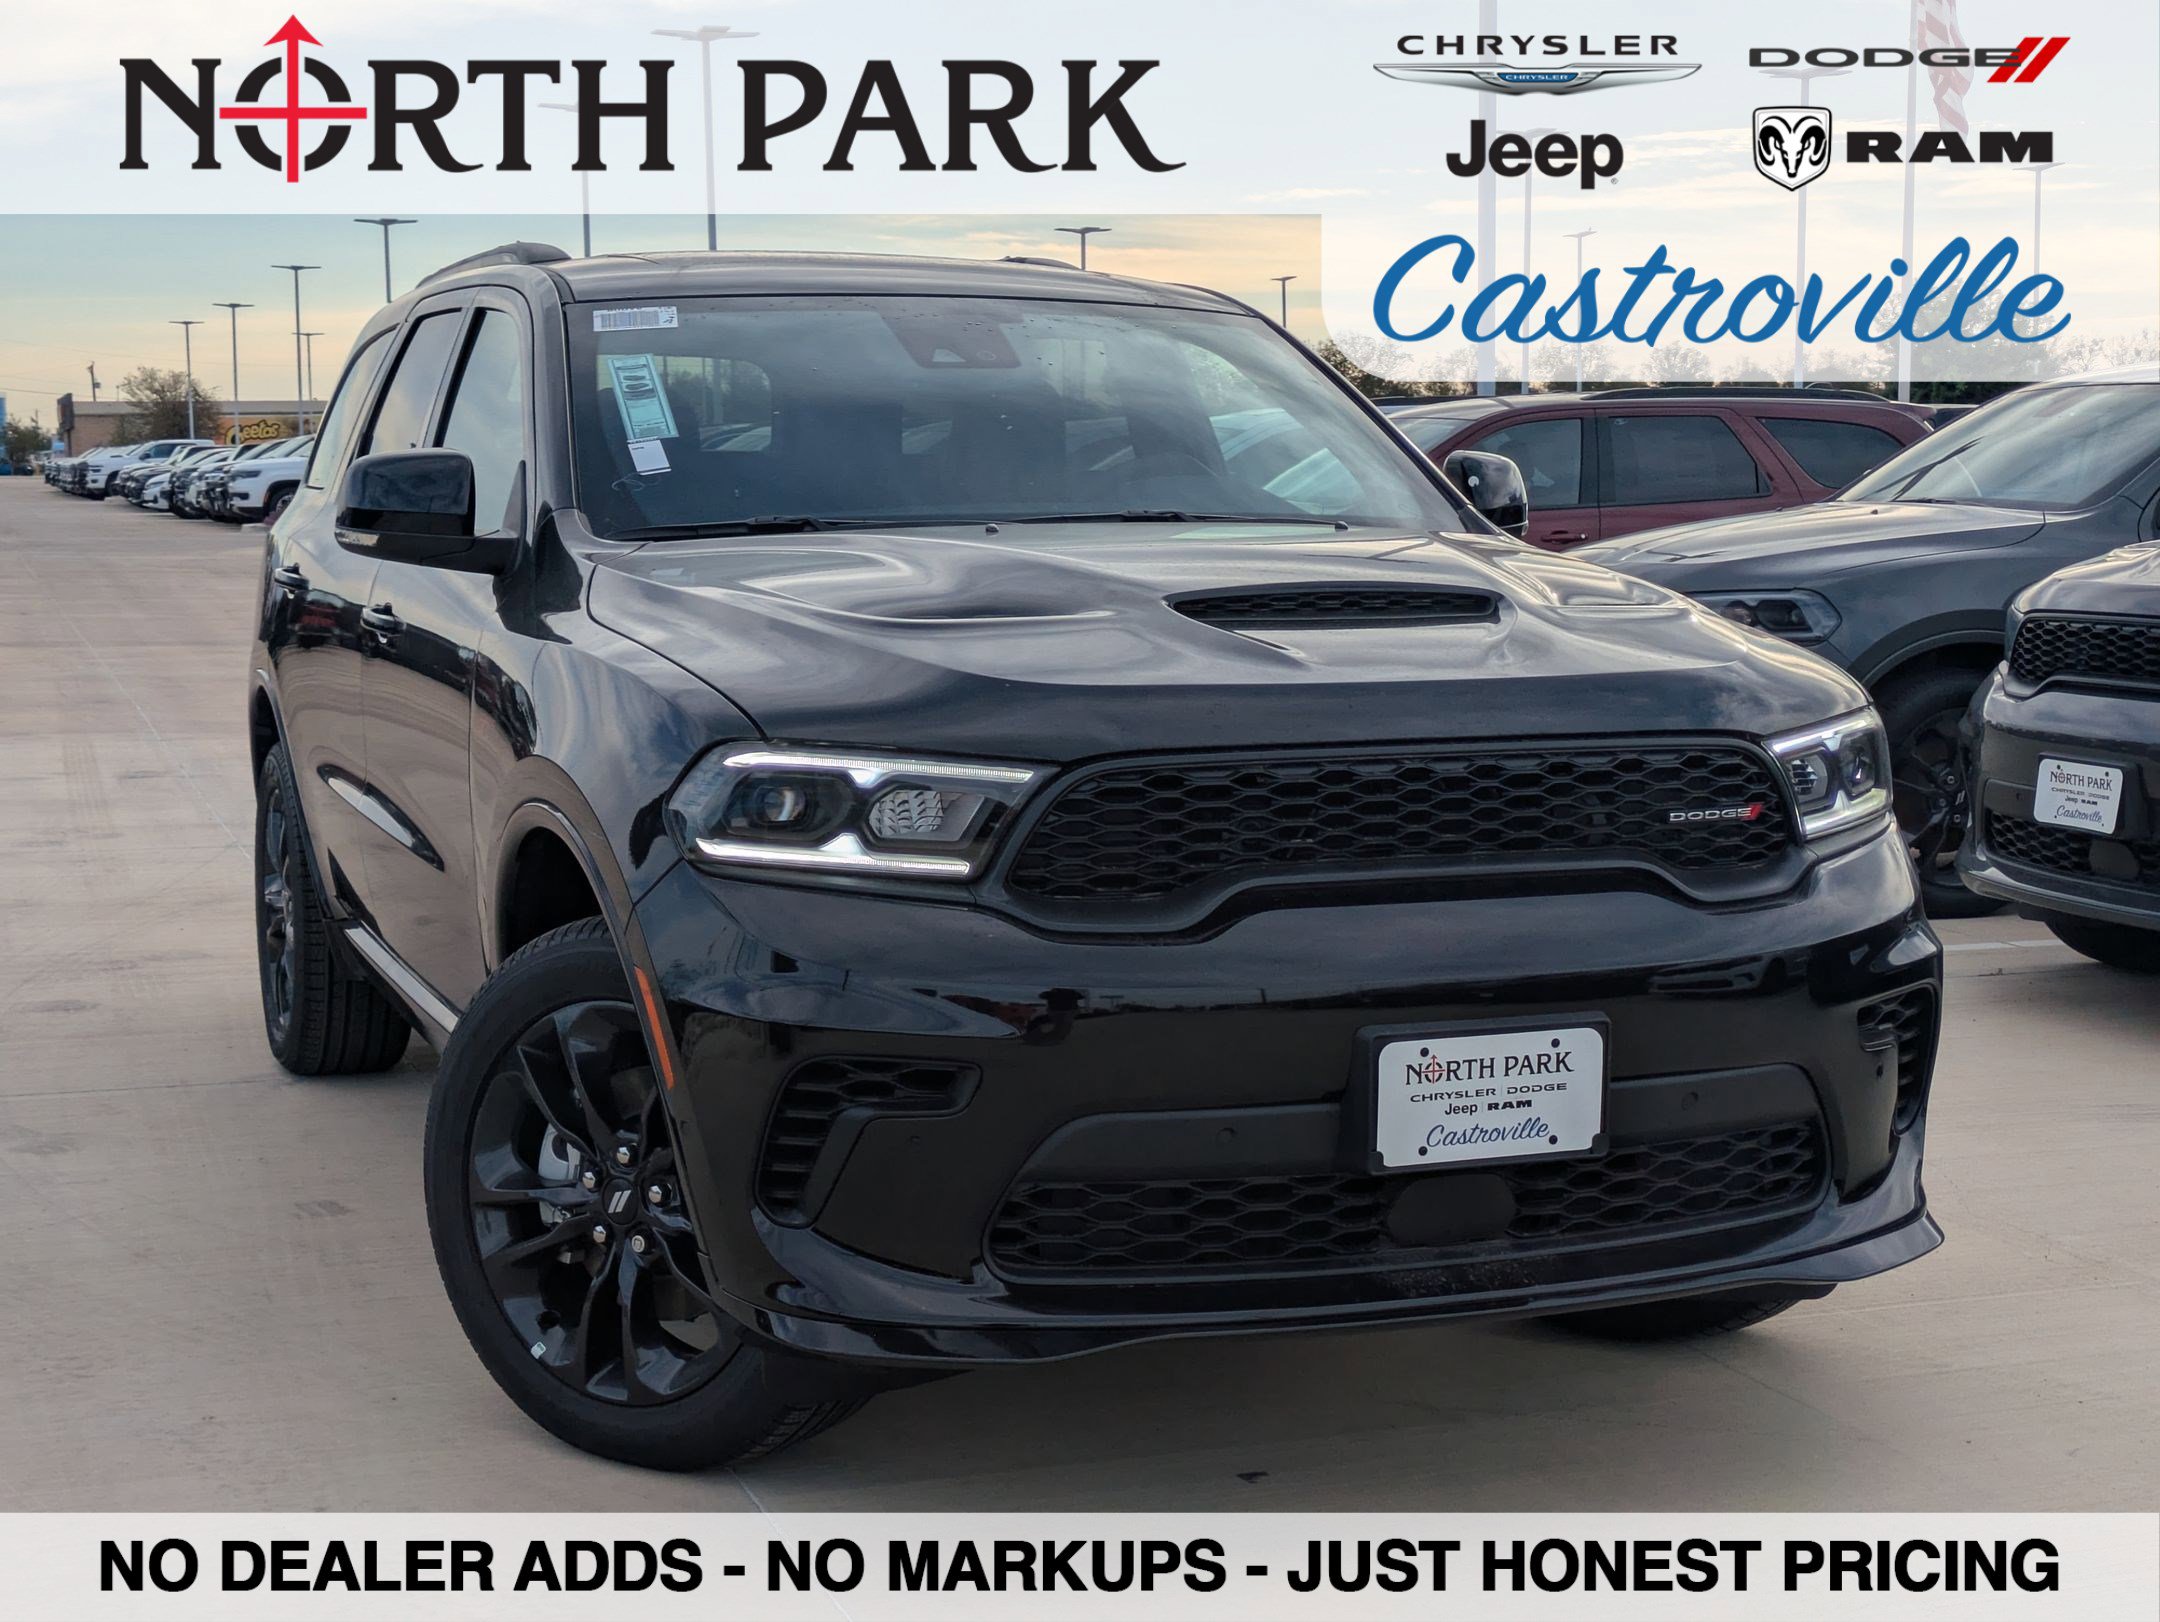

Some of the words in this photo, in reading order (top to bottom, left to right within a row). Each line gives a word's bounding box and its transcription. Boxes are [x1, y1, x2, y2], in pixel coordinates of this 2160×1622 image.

[2050, 771, 2085, 786] NORTH
[2087, 777, 2112, 791] PARK
[1669, 807, 1752, 821] DODGE
[2056, 805, 2103, 823] Castroville
[1405, 1056, 1496, 1086] NORTH
[1503, 1051, 1575, 1077] PARK
[1410, 1087, 1497, 1103] CHRYSLER
[1507, 1082, 1568, 1095] DODGE
[1444, 1102, 1478, 1116] Jeep
[1487, 1099, 1532, 1111] RAM
[1426, 1116, 1549, 1148] Castroville
